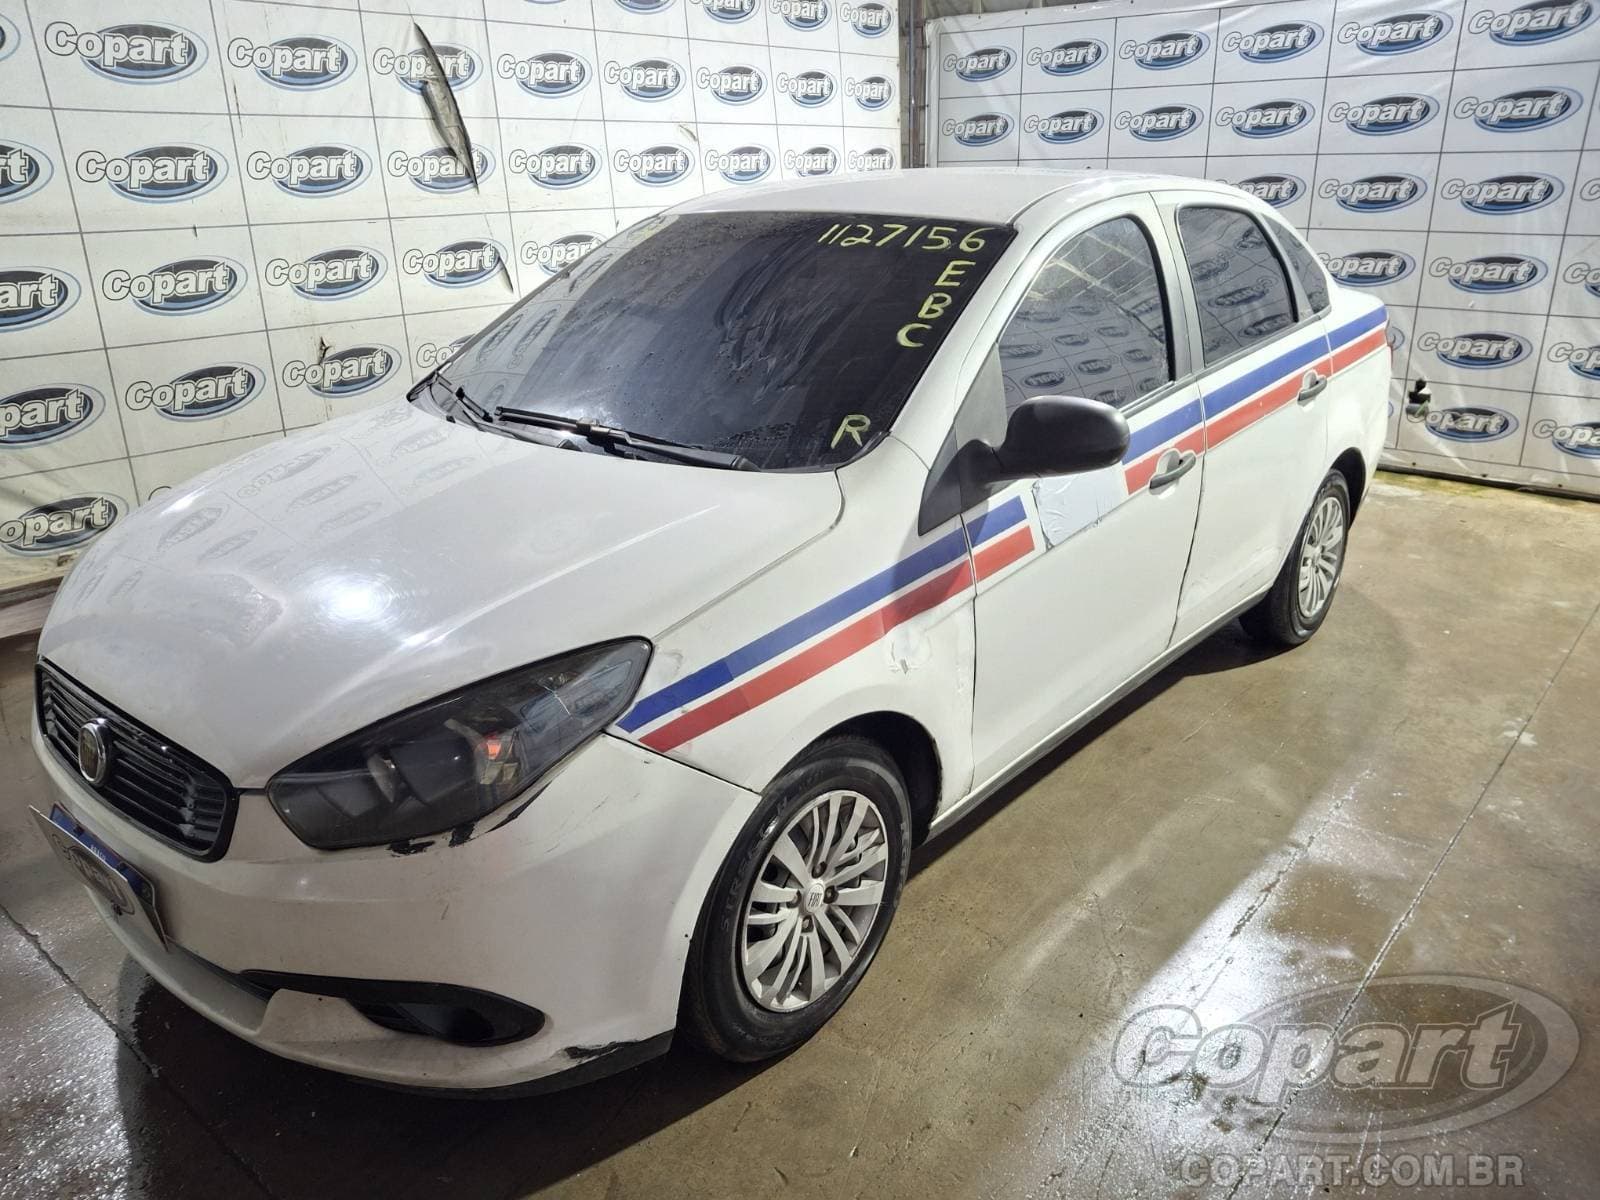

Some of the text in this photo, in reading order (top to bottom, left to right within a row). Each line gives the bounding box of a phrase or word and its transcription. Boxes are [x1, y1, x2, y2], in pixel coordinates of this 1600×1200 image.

[840, 3, 890, 27] Copart
[1468, 0, 1590, 38] Copart
[44, 21, 189, 68] Copart
[1222, 24, 1315, 55] Copart
[1337, 15, 1441, 47] Copart
[228, 37, 342, 76] Copart
[943, 50, 1008, 74] Copart
[1027, 43, 1100, 68] Copart
[1119, 33, 1202, 63] Copart
[497, 53, 582, 87] Copart
[604, 60, 678, 90] Copart
[696, 66, 761, 95] Copart
[776, 72, 833, 98] Copart
[845, 77, 890, 101] Copart
[1114, 107, 1194, 134] Copart
[1215, 102, 1306, 129] Copart
[1328, 97, 1429, 127] Copart
[1454, 92, 1570, 125] Copart
[942, 116, 1006, 137] Copart
[1024, 112, 1096, 136] Copart
[76, 150, 210, 189] Copart
[247, 150, 357, 185] Copart
[509, 149, 592, 179] Copart
[614, 149, 688, 177] Copart
[705, 149, 768, 176] Copart
[784, 149, 836, 176] Copart
[848, 150, 892, 171] Copart
[1319, 178, 1419, 204] Copart
[1442, 178, 1554, 205] Copart
[818, 224, 996, 252] 1127156
[265, 252, 373, 292] Copart
[403, 243, 495, 278] Copart
[1429, 256, 1534, 283] Copart
[102, 262, 230, 304] Copart
[1417, 332, 1521, 360] Copart
[282, 349, 387, 389] Copart
[125, 367, 248, 412] Copart
[0, 388, 84, 438] part
[830, 414, 871, 449] R
[0, 497, 108, 547] opart
